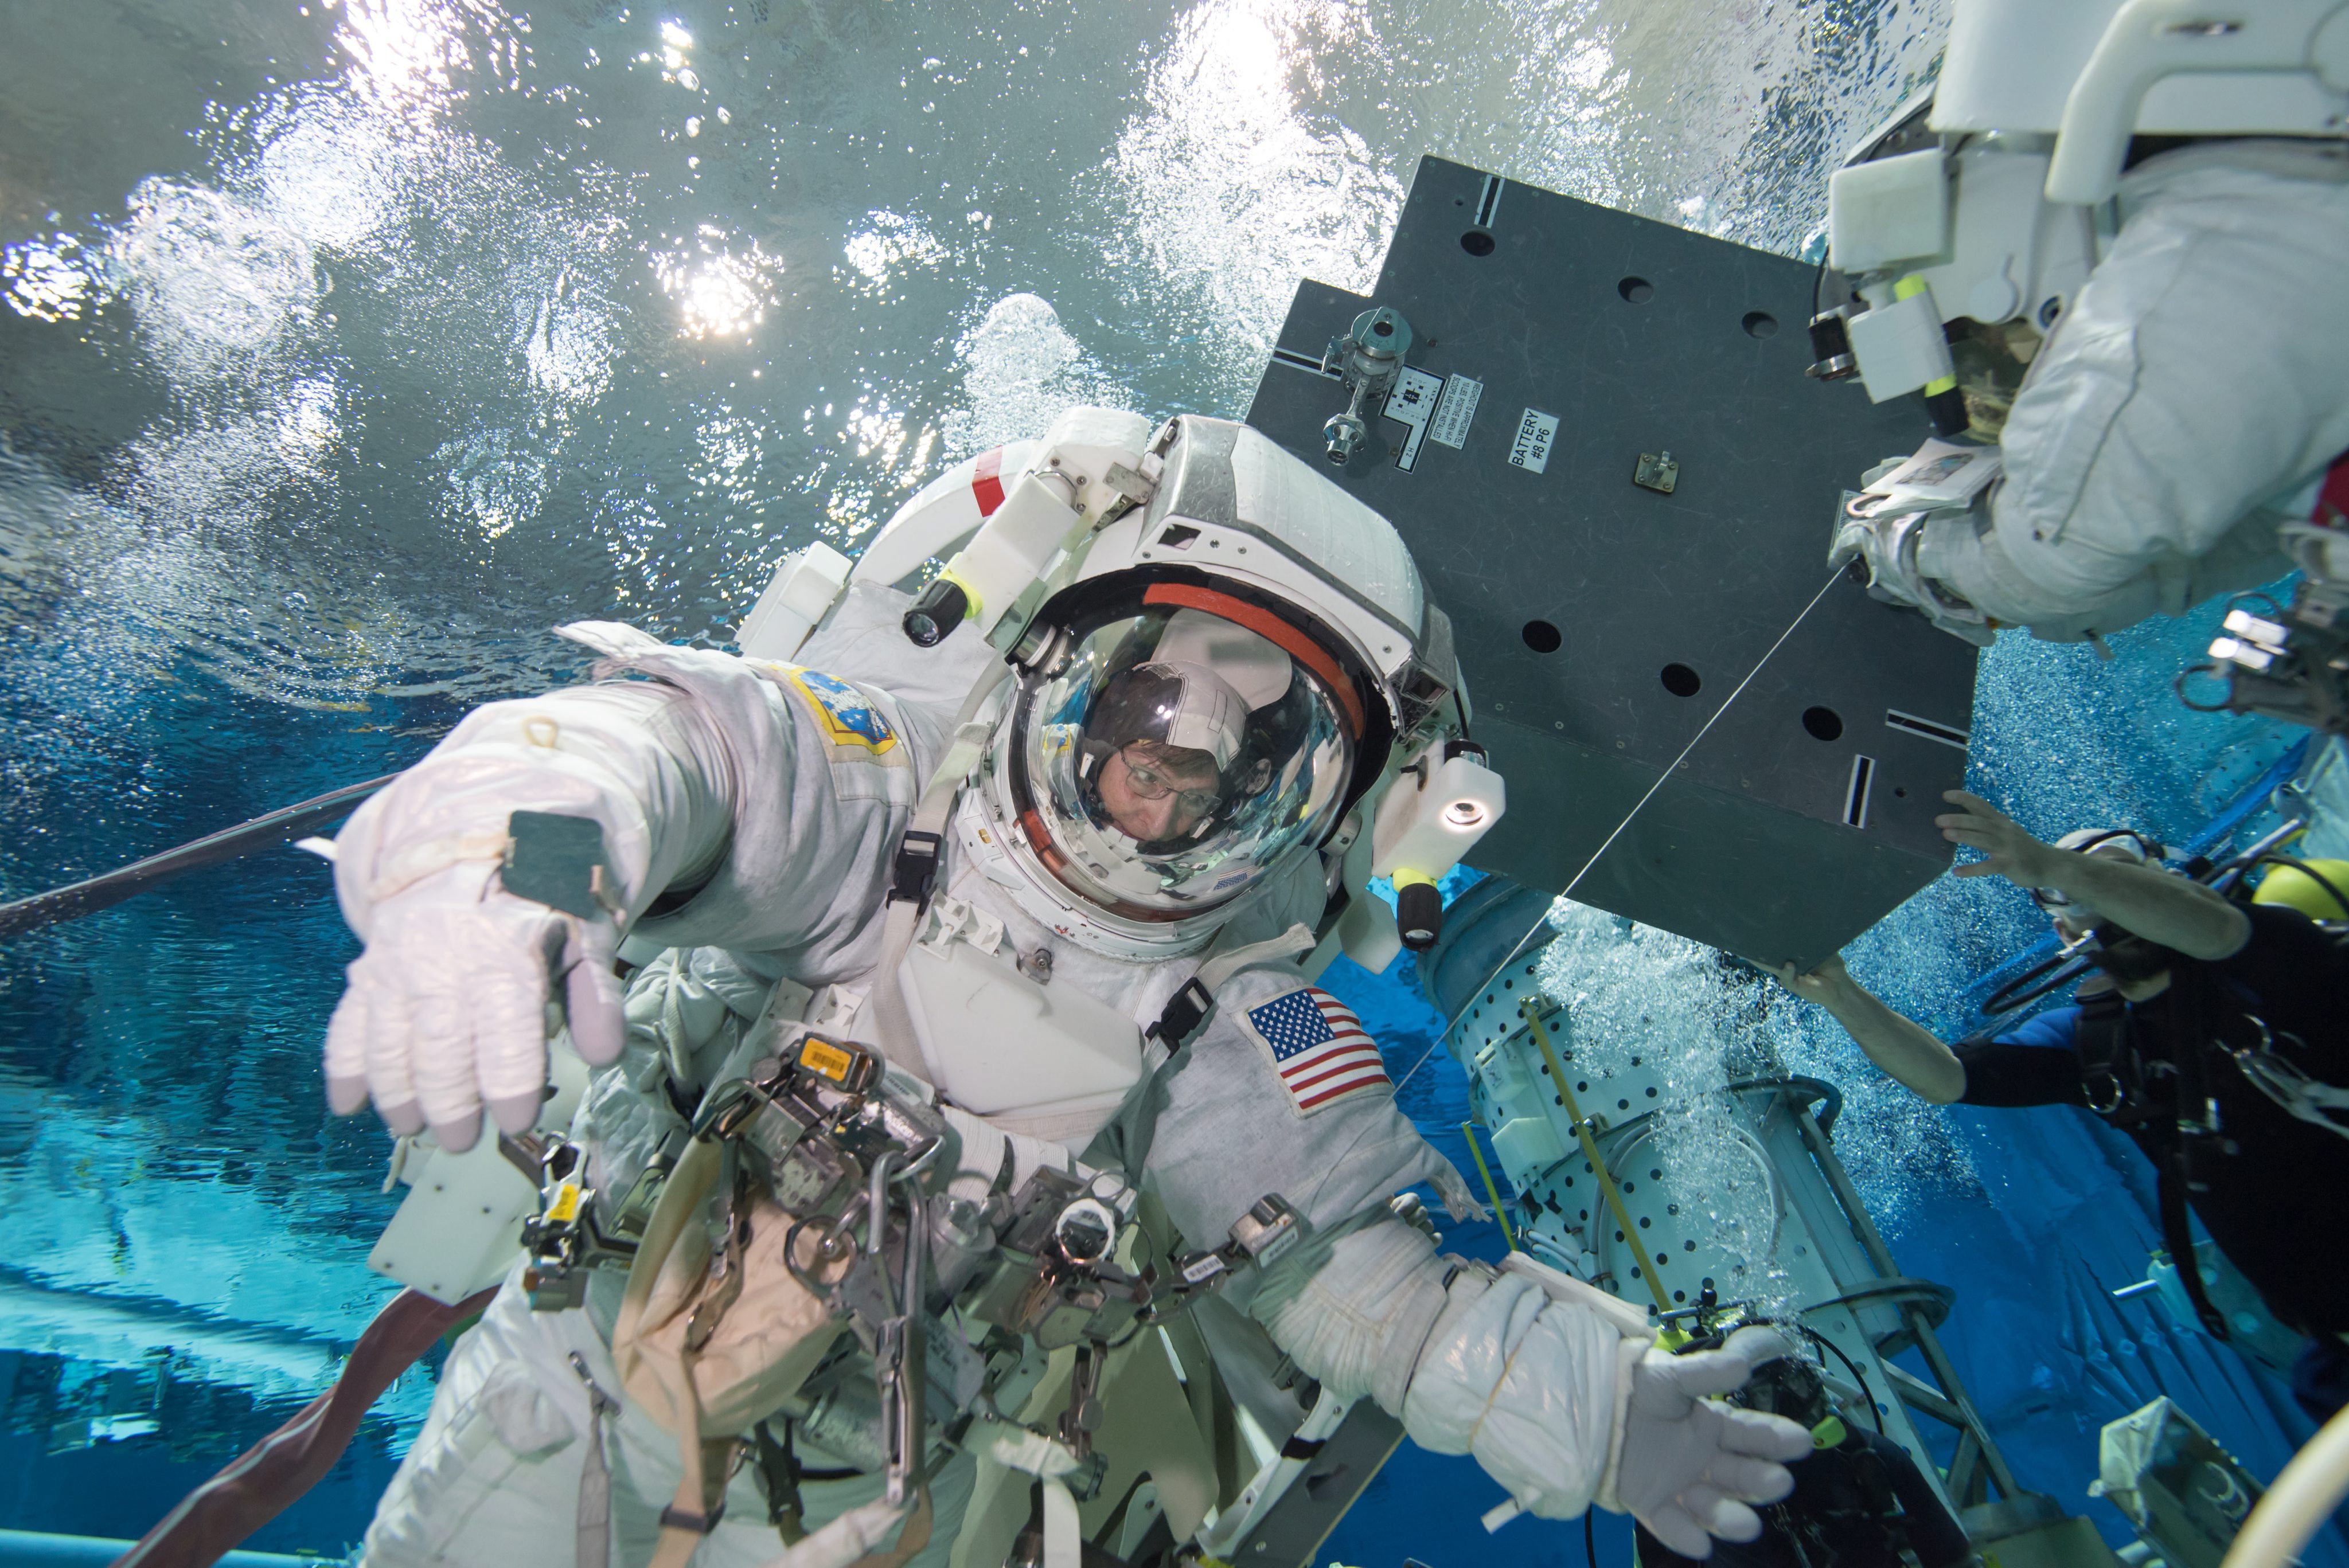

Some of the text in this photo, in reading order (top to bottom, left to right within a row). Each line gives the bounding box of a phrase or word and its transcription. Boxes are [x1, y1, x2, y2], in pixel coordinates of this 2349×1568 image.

[1433, 377, 1461, 439] SCOOPS ARE NOT INSTALLED
[1452, 397, 1465, 418] POSITIVE
[1468, 382, 1481, 407] WEIGHOUT
[1444, 430, 1453, 441] HI-FI
[1448, 417, 1458, 431] WHEN
[1453, 410, 1472, 448] APPROXIMATELY
[1512, 410, 1539, 466] BATTERY
[1531, 428, 1550, 460] #8 P6
